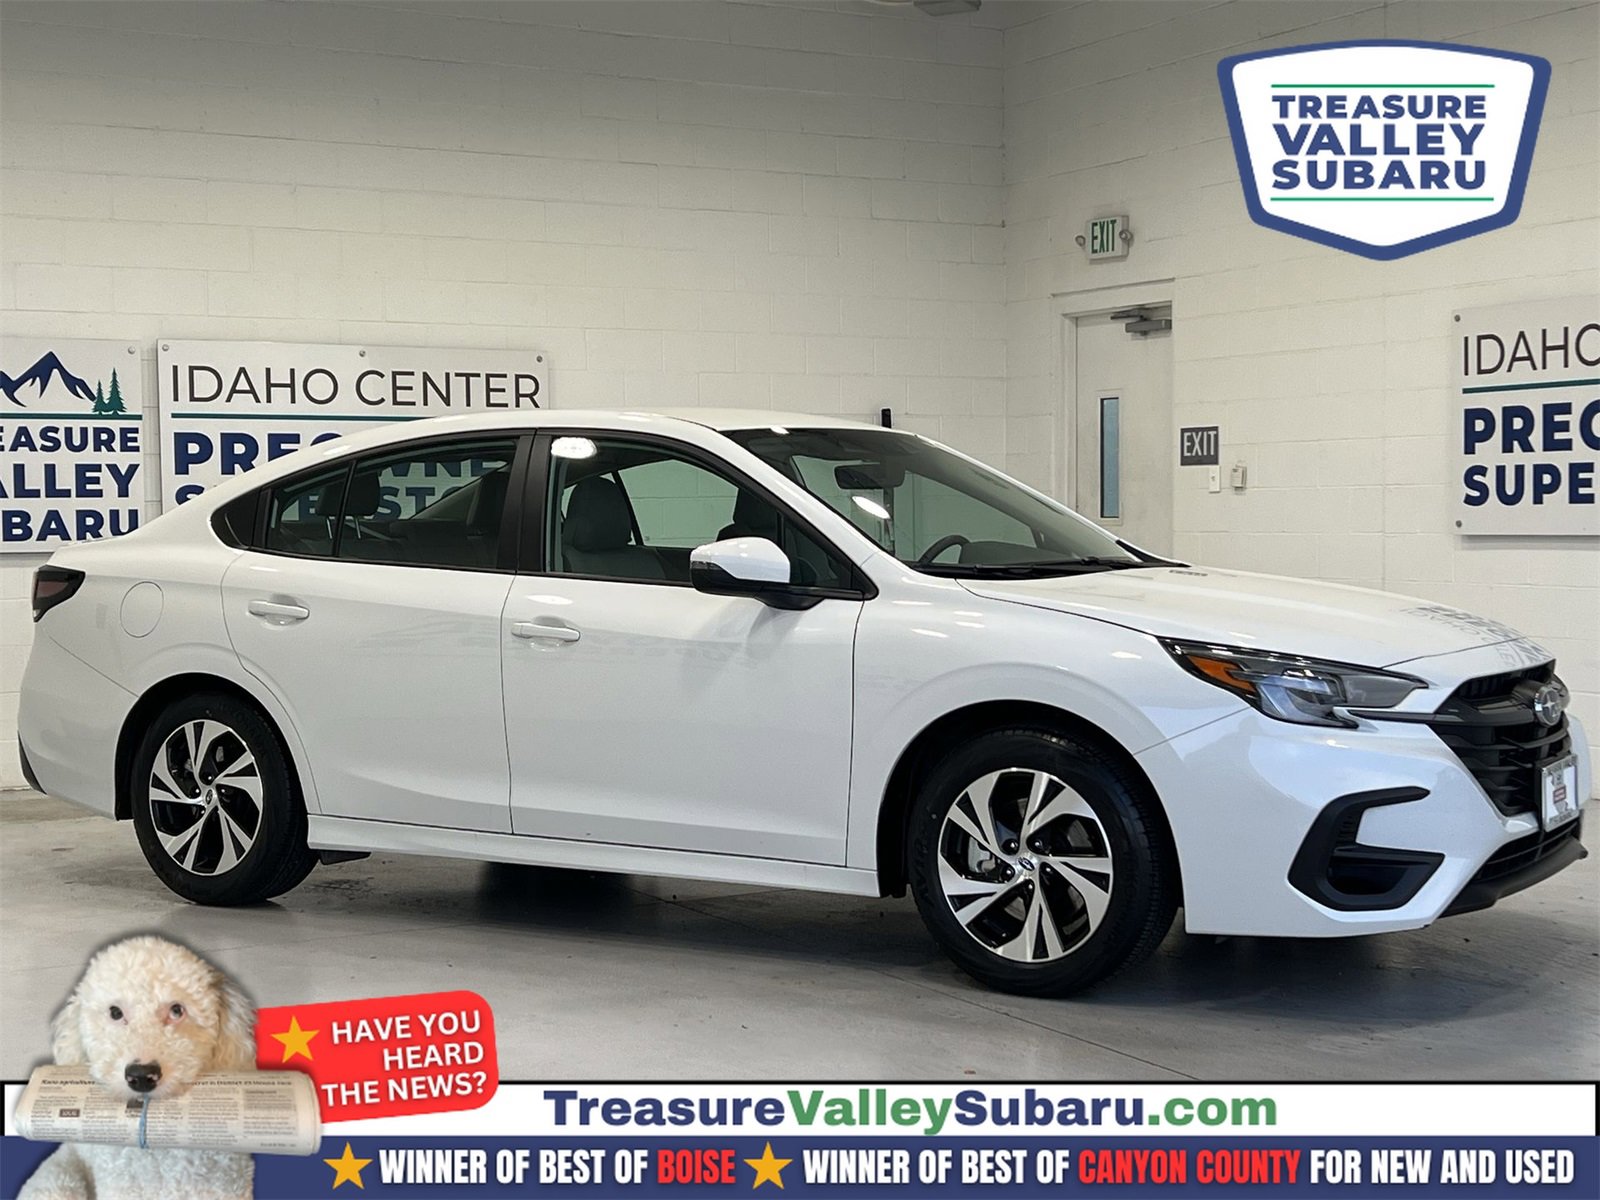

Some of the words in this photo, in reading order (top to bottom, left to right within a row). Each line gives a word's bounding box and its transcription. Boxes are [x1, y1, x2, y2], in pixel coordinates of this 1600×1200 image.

[1091, 219, 1117, 254] EXIT
[172, 364, 339, 405] IDAHO
[354, 368, 542, 409] CENTER
[0, 425, 141, 453] ASURE
[1182, 430, 1217, 457] EXIT
[0, 463, 141, 499] LLEY
